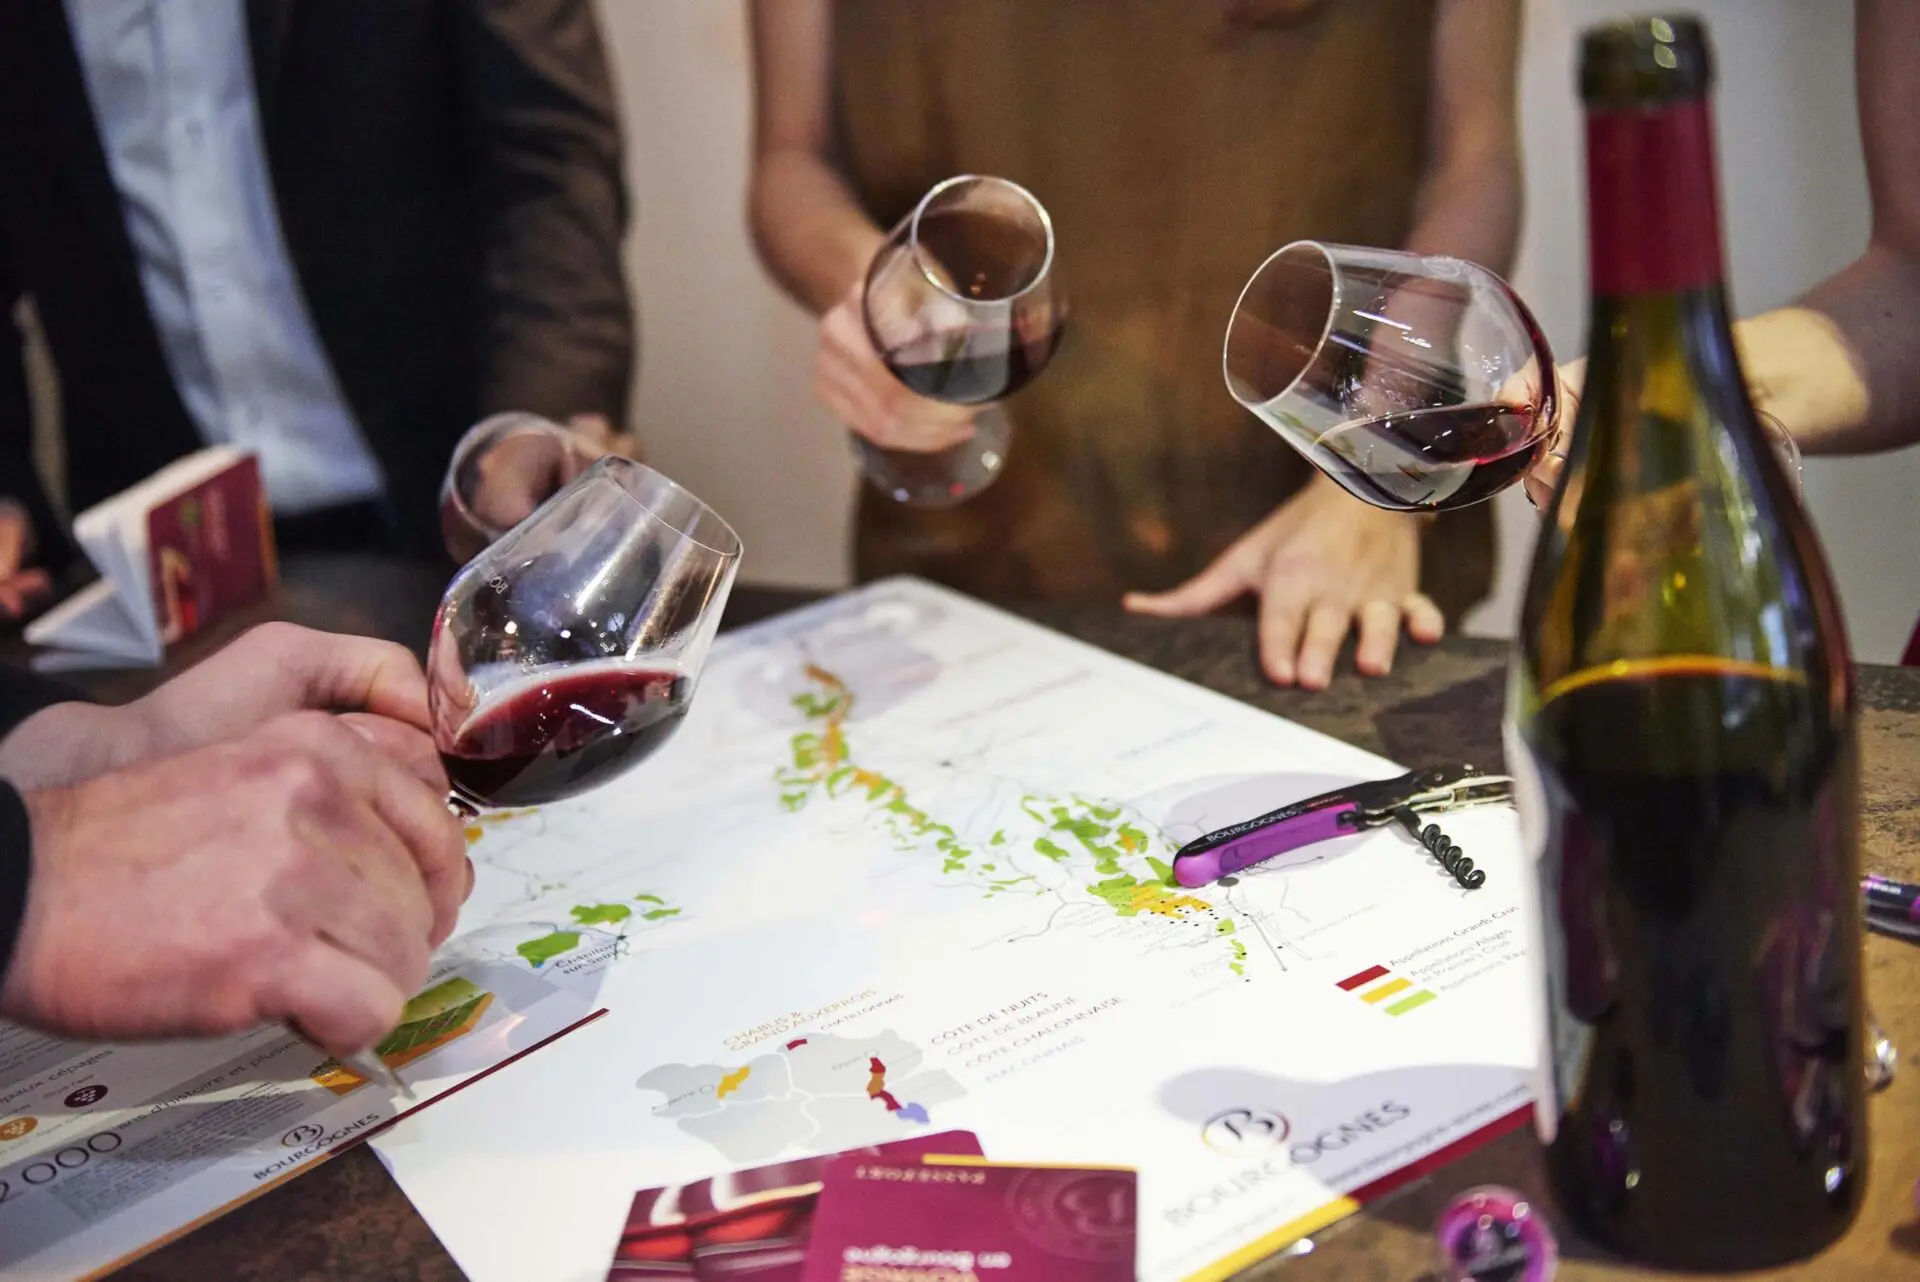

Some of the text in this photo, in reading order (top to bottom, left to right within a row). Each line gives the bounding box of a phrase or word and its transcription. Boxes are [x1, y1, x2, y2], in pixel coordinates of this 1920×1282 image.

[1206, 808, 1298, 843] BOURGOGNES
[730, 988, 877, 1052] GRAND AUXERROIS
[976, 1011, 1001, 1027] DE
[1000, 991, 1049, 1015] NUITS
[723, 1014, 789, 1046] CHABLIS
[992, 1021, 1018, 1036] DE
[48, 1049, 114, 1082] cépages
[21, 1131, 122, 1185] 000
[116, 1112, 148, 1131] ans
[150, 1074, 225, 1115] d'histoire
[228, 1064, 248, 1078] et
[253, 1112, 380, 1181] BOURGOGNES
[1161, 1098, 1412, 1228] BOURGOGNES
